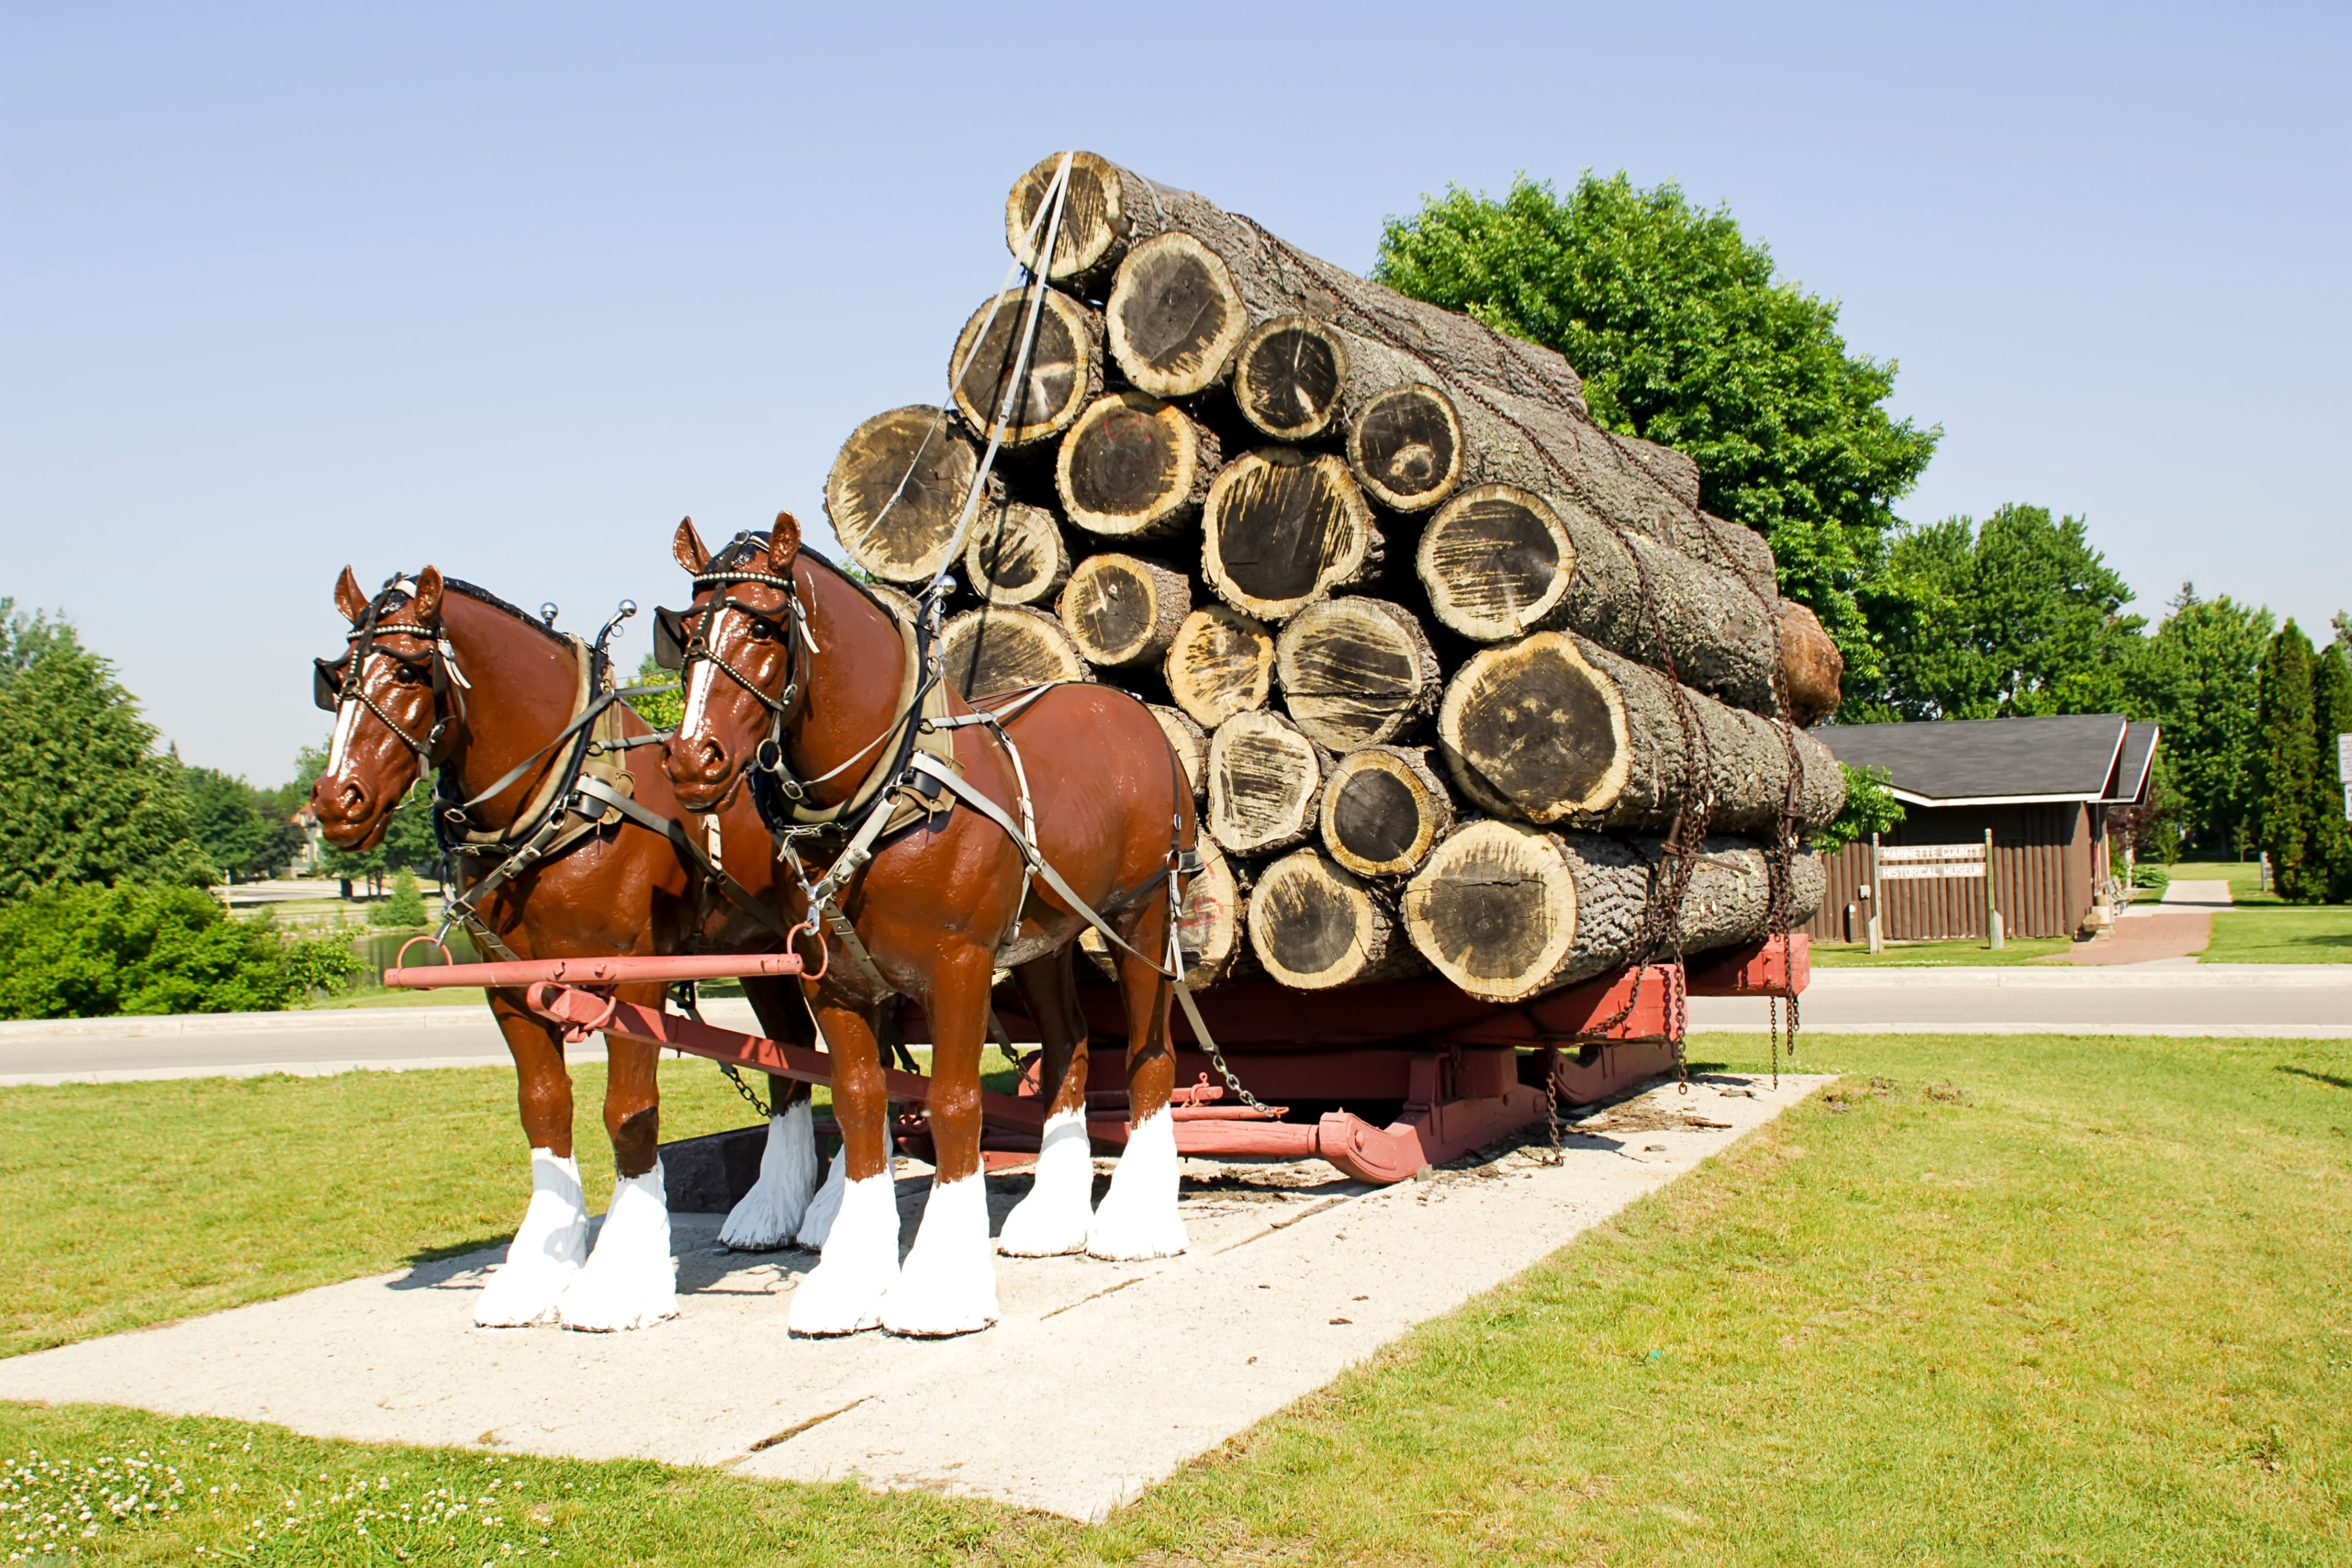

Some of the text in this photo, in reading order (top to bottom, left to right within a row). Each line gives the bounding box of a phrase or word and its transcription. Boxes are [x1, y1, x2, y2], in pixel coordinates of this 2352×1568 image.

[1884, 847, 1980, 859] MARINETTE COUNTY
[1883, 865, 1984, 878] HISTORICAL MUSEUM
